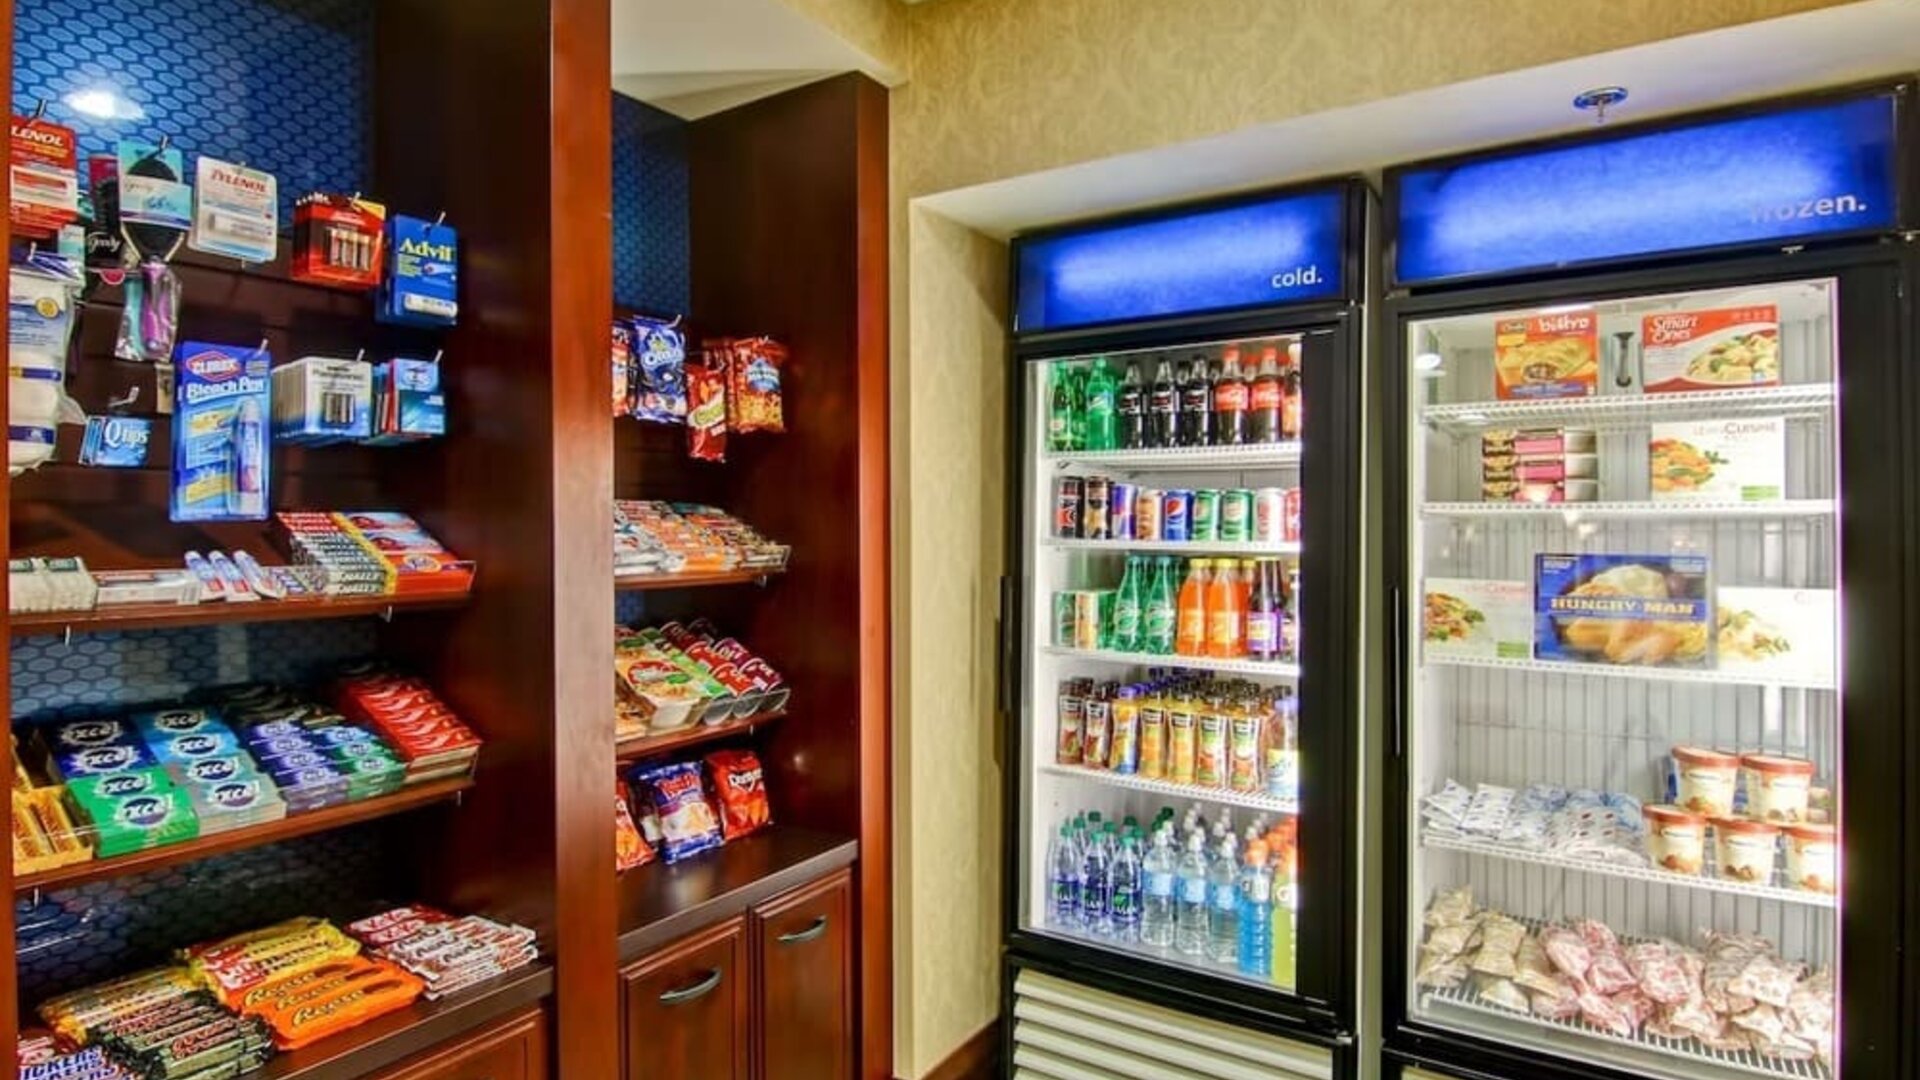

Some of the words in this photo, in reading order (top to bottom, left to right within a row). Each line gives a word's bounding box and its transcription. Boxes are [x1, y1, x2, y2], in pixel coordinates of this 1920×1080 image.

[211, 168, 267, 193] TYLENOL
[400, 238, 456, 262] Advil
[1271, 264, 1323, 289] cold.
[186, 380, 237, 402] Bleach
[1551, 597, 1638, 613] HUNGRY
